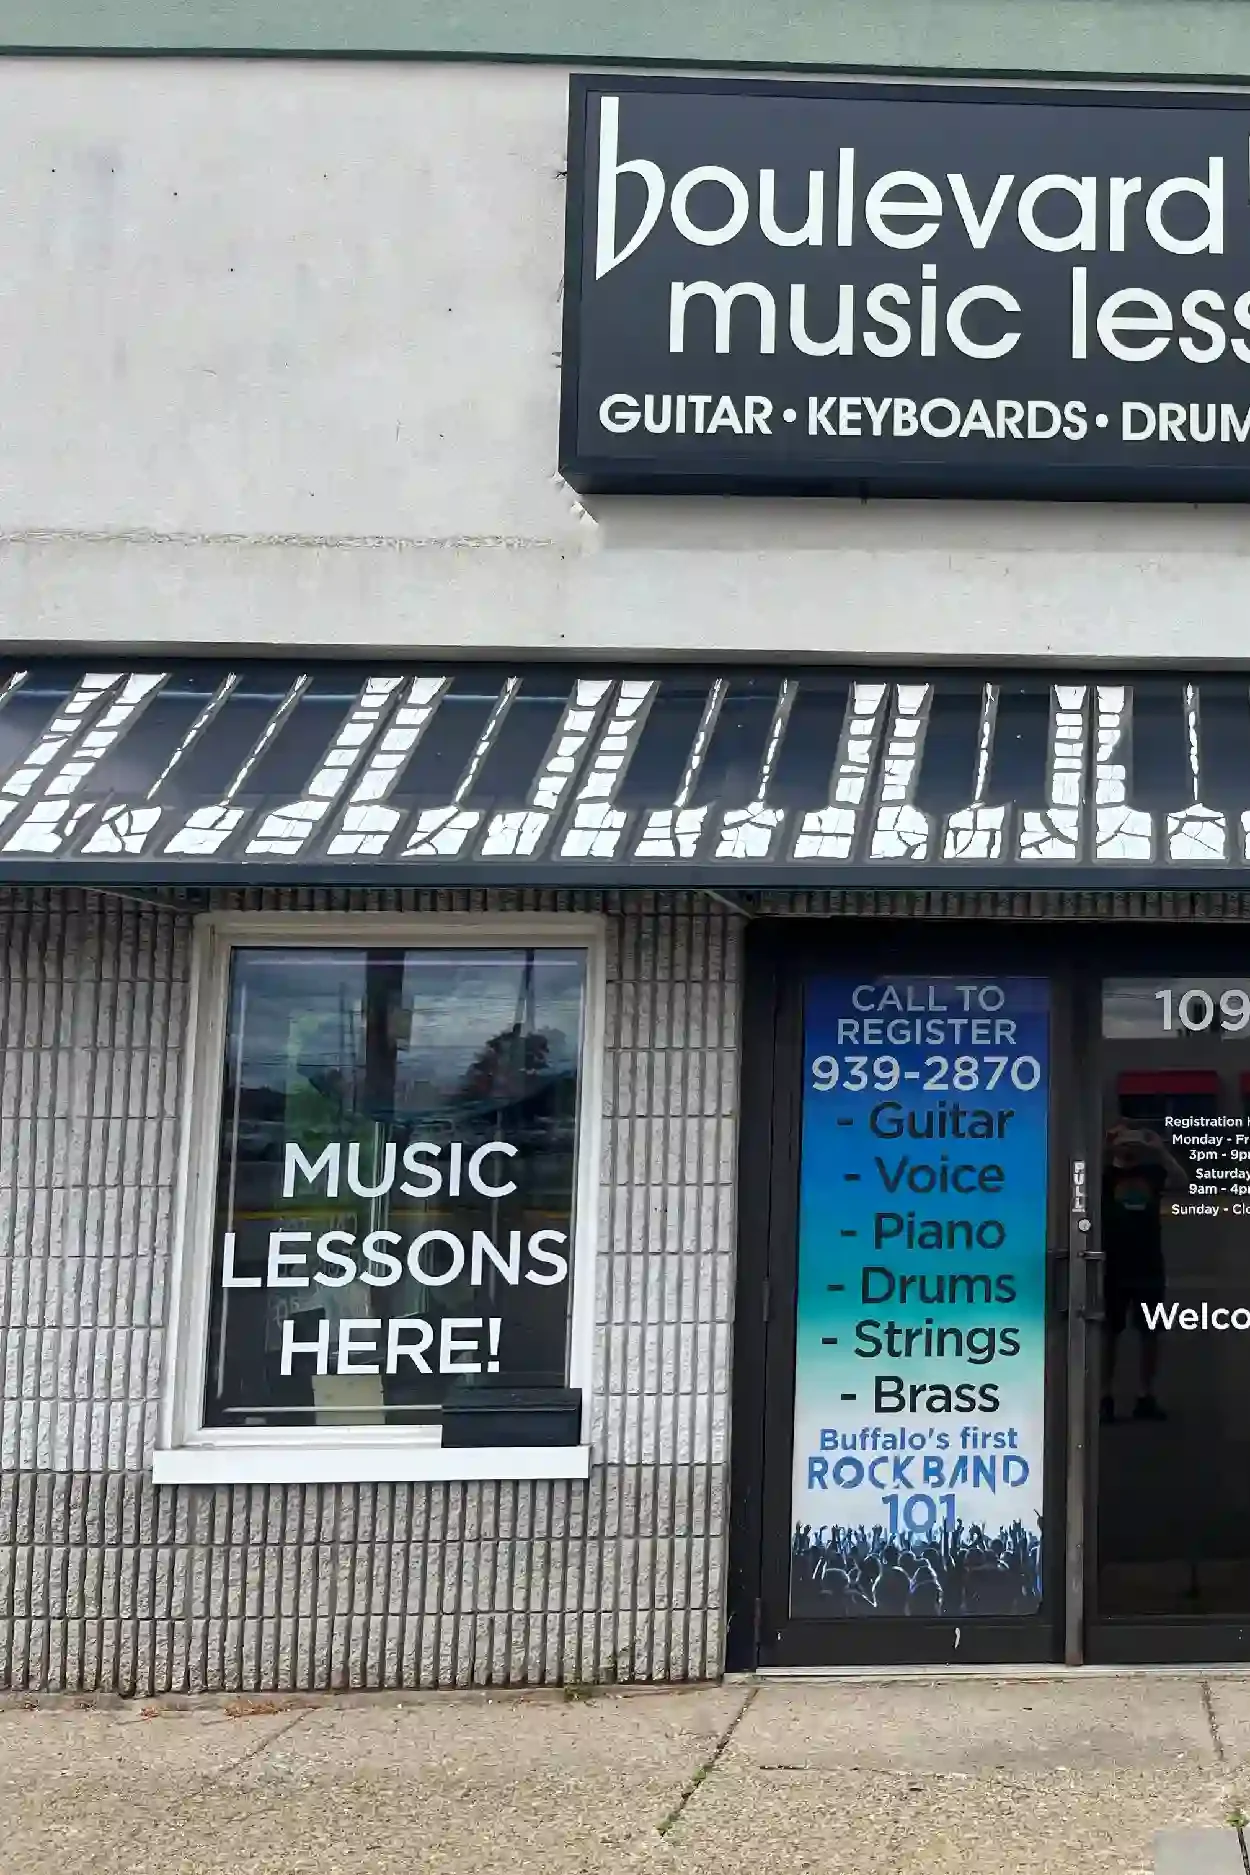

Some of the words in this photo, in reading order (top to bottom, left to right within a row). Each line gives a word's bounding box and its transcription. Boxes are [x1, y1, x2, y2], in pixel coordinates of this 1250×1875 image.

[596, 96, 1225, 281] boulevard
[669, 263, 1022, 360] music
[598, 393, 773, 435] GUITAR
[808, 396, 1089, 442] KEYBOARDS
[851, 984, 948, 1012] CALL
[955, 985, 1005, 1012] TO
[837, 1018, 1017, 1046] REGISTER
[811, 1054, 1041, 1092] 939-2870
[869, 1099, 1015, 1140] Guitar
[1164, 1115, 1243, 1129] Registration
[1172, 1133, 1223, 1147] Monday
[1188, 1149, 1218, 1162] 3pm
[282, 1140, 519, 1199] MUSIC
[874, 1154, 1006, 1194] Voice
[1188, 1183, 1218, 1195] 9am
[873, 1210, 1007, 1250] Piano
[1171, 1203, 1220, 1217] Sunday
[221, 1228, 569, 1288] LESSONS
[861, 1265, 1017, 1305] Drums
[279, 1316, 501, 1376] HERE!
[853, 1317, 1021, 1365] Strings
[874, 1375, 1001, 1413] Brass
[820, 1427, 950, 1451] Buffalo's
[960, 1426, 1018, 1450] first
[881, 1493, 957, 1534] 101
